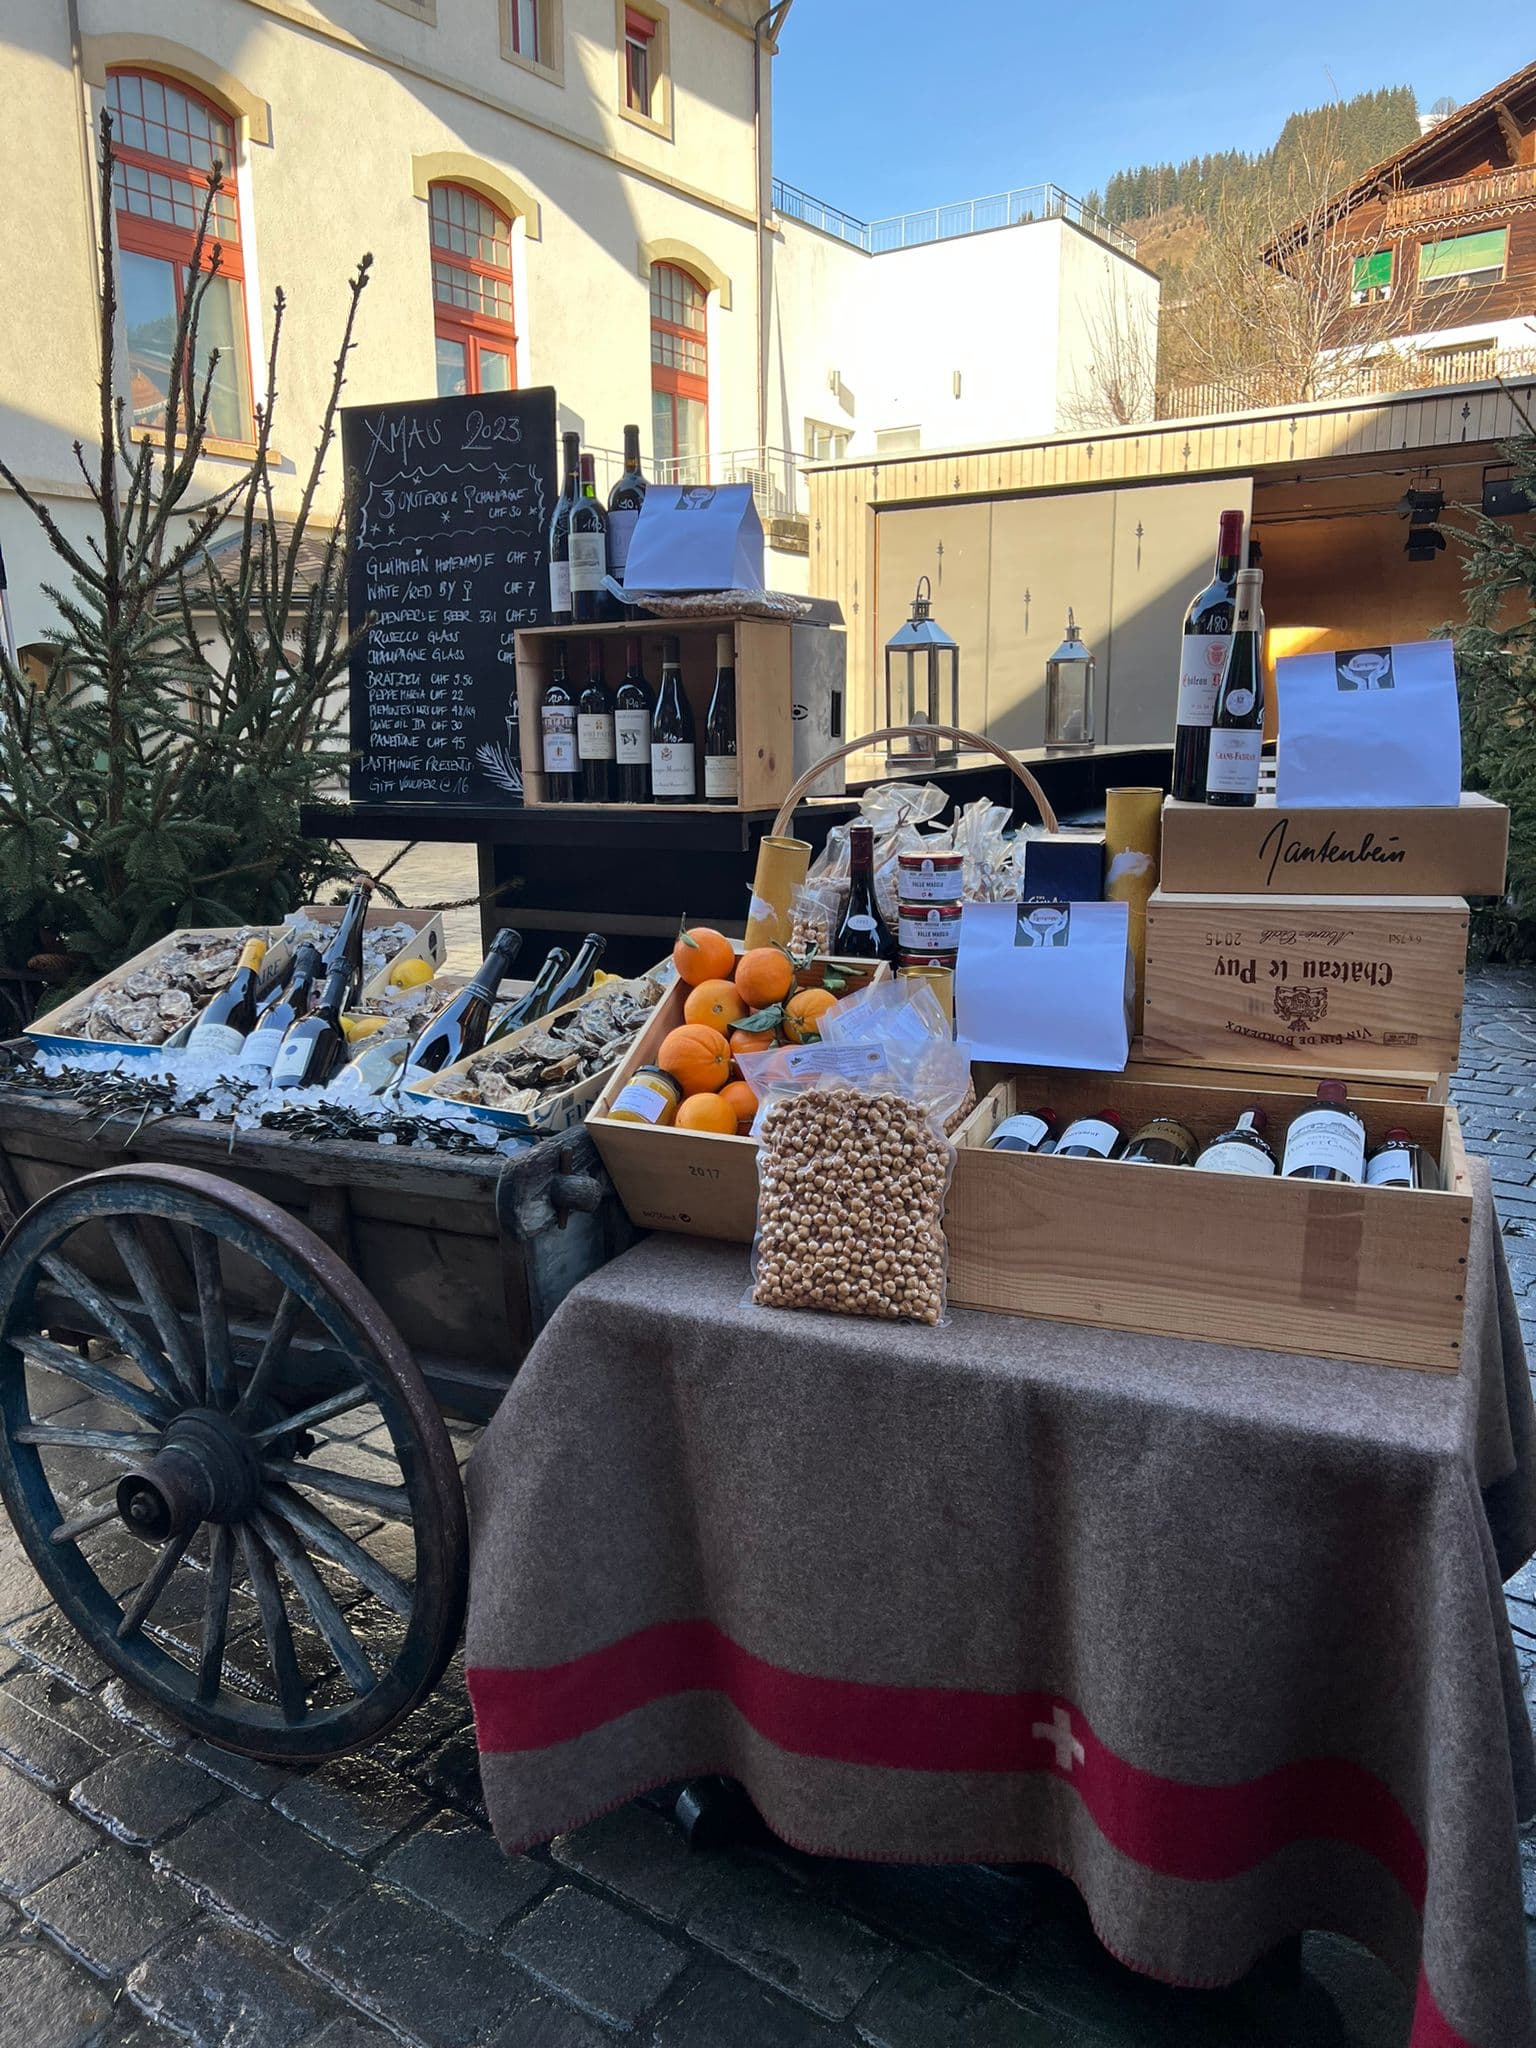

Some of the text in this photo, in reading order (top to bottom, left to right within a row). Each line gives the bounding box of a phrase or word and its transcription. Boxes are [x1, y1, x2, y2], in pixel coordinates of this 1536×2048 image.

[461, 410, 522, 450] 2023
[378, 489, 396, 519] 3
[399, 489, 448, 512] OYSTERS
[475, 488, 528, 505] CHAMPAGNE
[489, 504, 521, 519] CHF 30
[435, 553, 495, 573] HOMEMADE
[507, 551, 526, 564] CHF
[533, 550, 542, 567] 7
[439, 581, 456, 600] BY
[504, 582, 524, 595] CHF
[527, 581, 536, 596] 7
[443, 609, 473, 624] BEER
[505, 609, 526, 623] CHF
[528, 609, 538, 624] 5
[1206, 614, 1228, 632] 180
[368, 630, 419, 649] PROSECCO
[427, 630, 460, 643] GLASS
[367, 648, 427, 664] CHAMPAGNE
[431, 648, 465, 661] GLASS
[430, 673, 449, 686] CHF
[430, 689, 447, 701] CHF
[451, 690, 465, 701] 22
[431, 705, 448, 716] CHF
[394, 719, 409, 730] OIL
[431, 720, 448, 731] CHF
[451, 719, 463, 731] 30
[426, 736, 448, 749] CHF
[451, 735, 467, 750] 45
[369, 777, 396, 794] GIFT
[399, 776, 438, 792] VOUCHER
[1205, 932, 1242, 946] 2015
[1214, 955, 1393, 987] Château le Puy
[1224, 1020, 1295, 1047] BORDEAUX
[1299, 1035, 1316, 1045] DE
[1346, 1026, 1373, 1041] VIN
[688, 1165, 721, 1180] 2017
